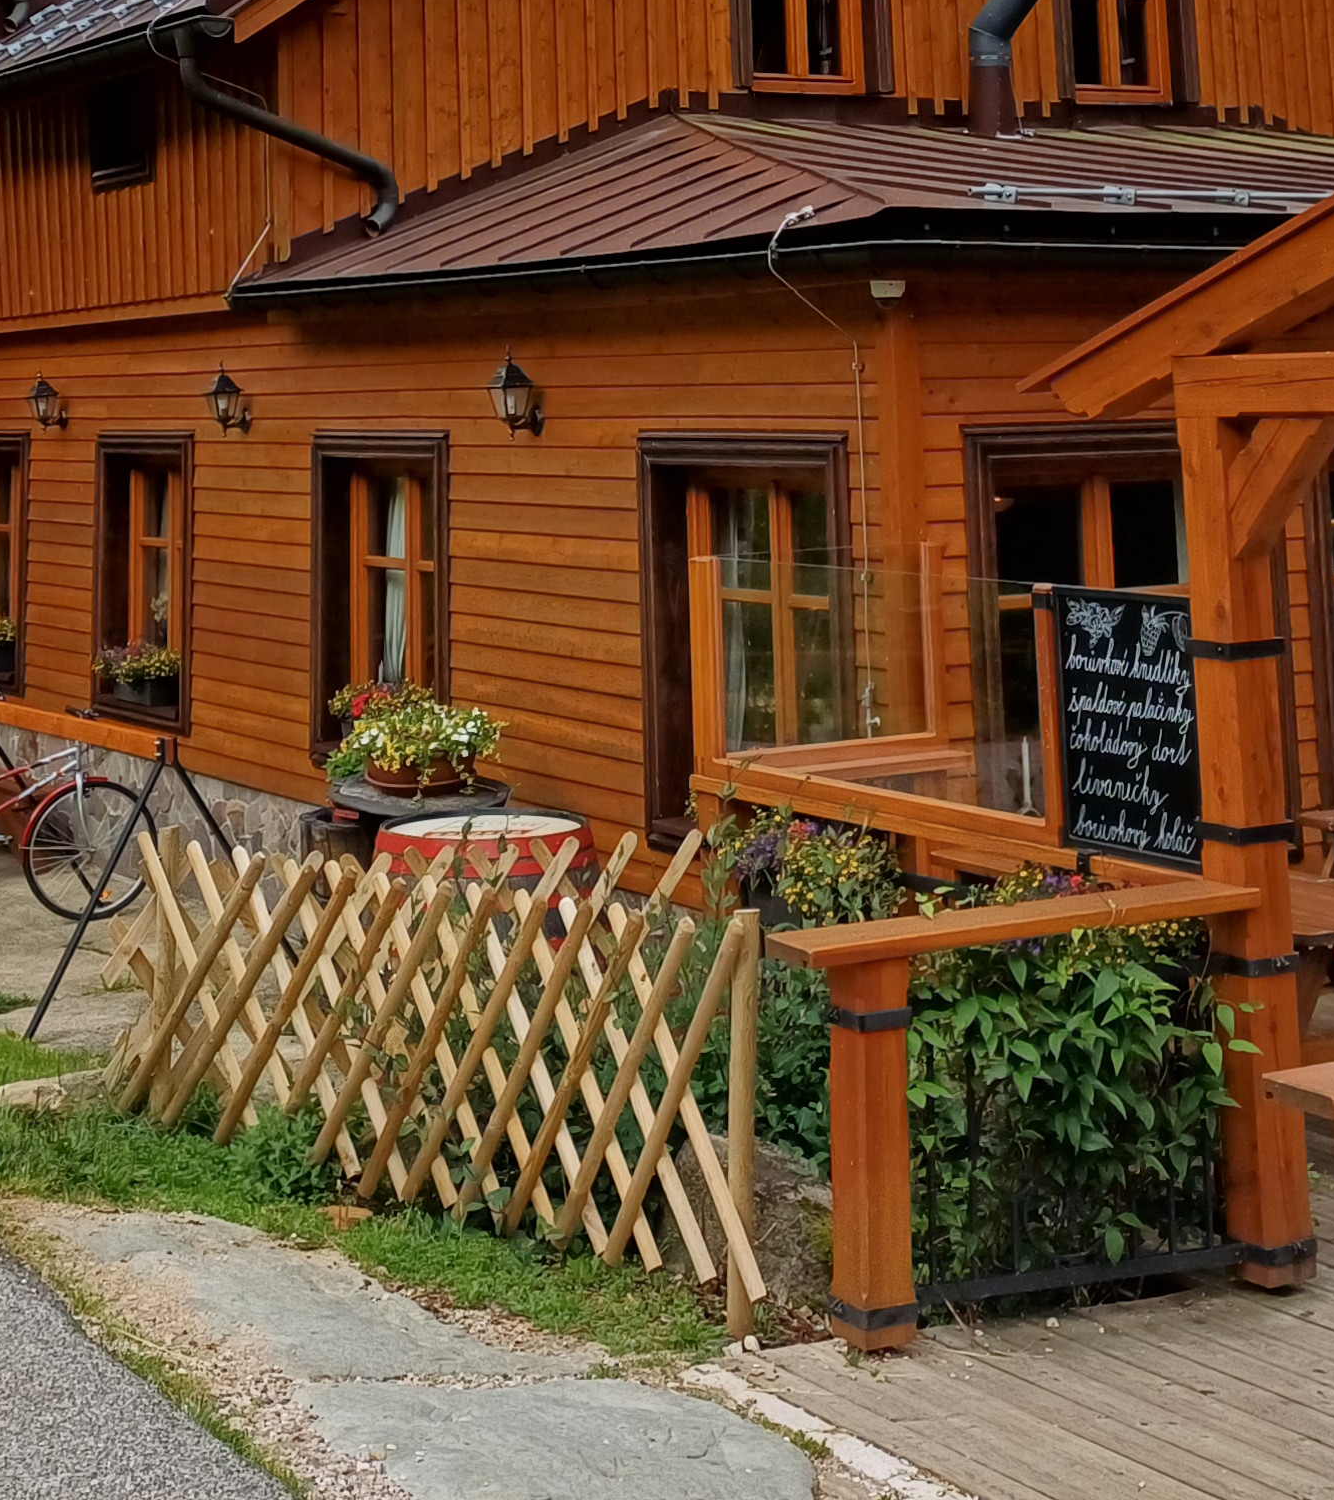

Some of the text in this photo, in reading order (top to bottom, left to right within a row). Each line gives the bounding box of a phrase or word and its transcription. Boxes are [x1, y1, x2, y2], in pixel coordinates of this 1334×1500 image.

[1126, 687, 1194, 734] palačinky
[1070, 718, 1192, 769] čokoládový dort
[1153, 811, 1197, 854] koláč
